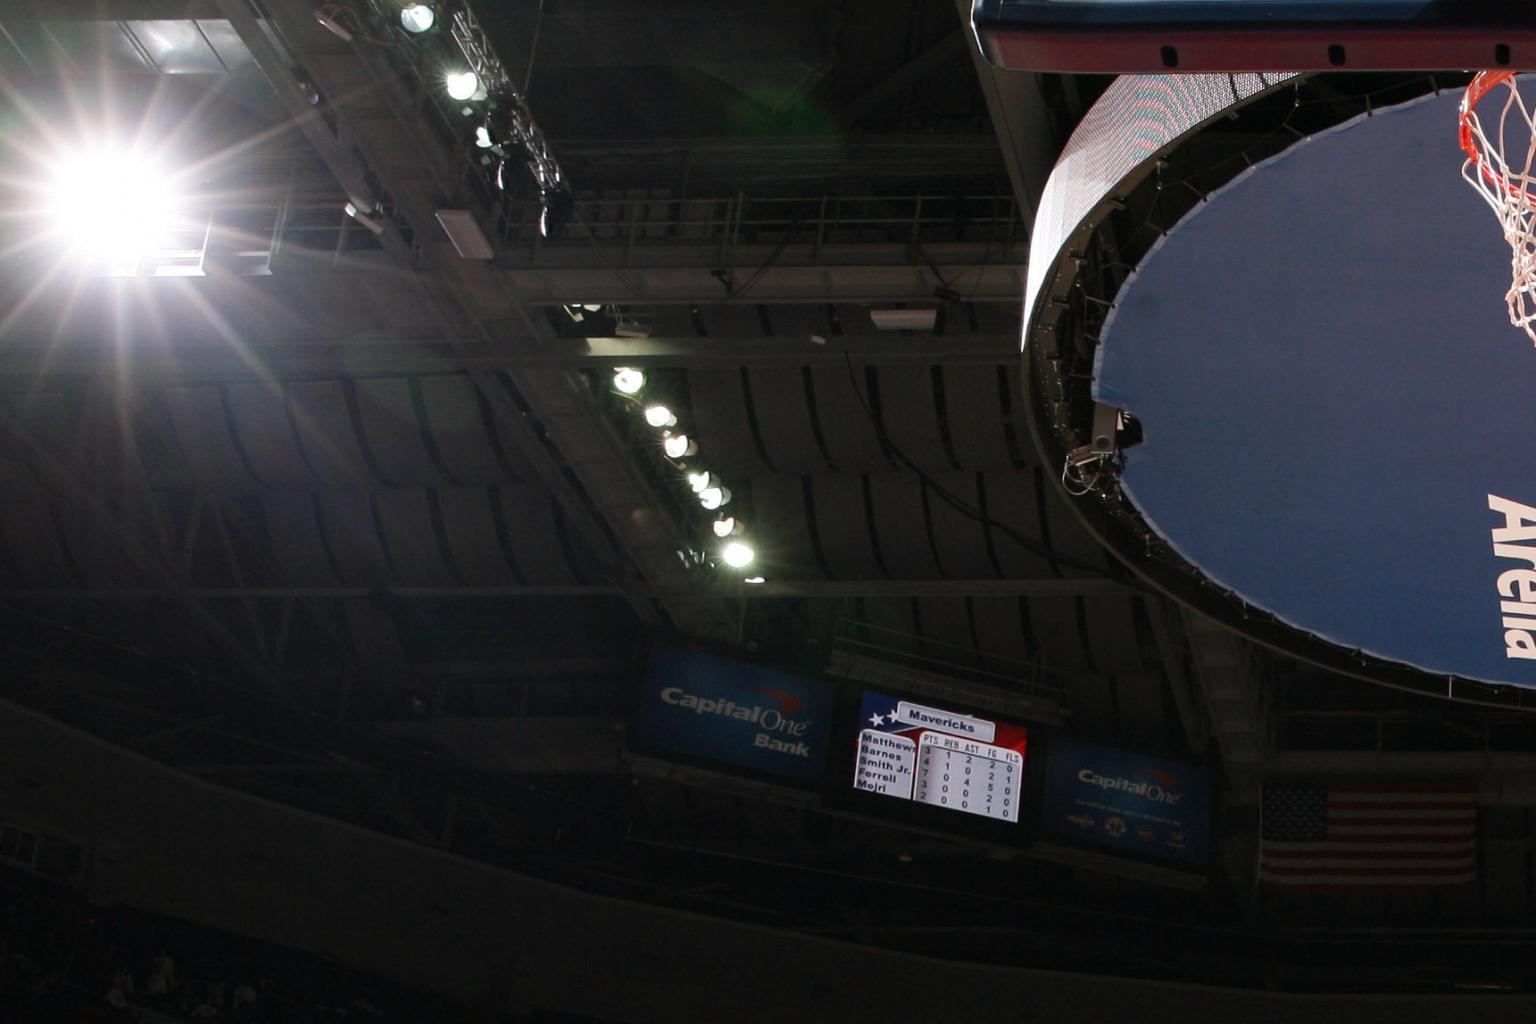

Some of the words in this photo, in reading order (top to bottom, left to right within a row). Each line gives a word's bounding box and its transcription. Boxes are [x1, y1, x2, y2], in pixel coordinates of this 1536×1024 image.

[908, 709, 975, 733] Mavericks
[754, 733, 810, 757] Bank
[924, 734, 939, 745] PTS
[944, 737, 960, 749] REB
[964, 742, 980, 754] AST
[987, 748, 997, 758] FG
[1005, 753, 1020, 764] FLS
[861, 745, 902, 762] Barnes
[965, 767, 971, 775] 0
[966, 756, 973, 764] 2
[989, 761, 996, 769] 2
[1007, 765, 1013, 773] 0
[860, 756, 893, 771] Smith
[896, 765, 911, 775] Jr.
[943, 774, 949, 782] 0
[964, 778, 970, 786] 4
[987, 783, 993, 792] 5
[1004, 787, 1011, 795] 0
[941, 796, 947, 804] 0
[961, 800, 968, 808] 0
[1002, 809, 1008, 817] 0
[942, 785, 948, 793] 0
[963, 789, 969, 798] 0
[986, 794, 993, 802] 2
[1003, 798, 1010, 806] 0
